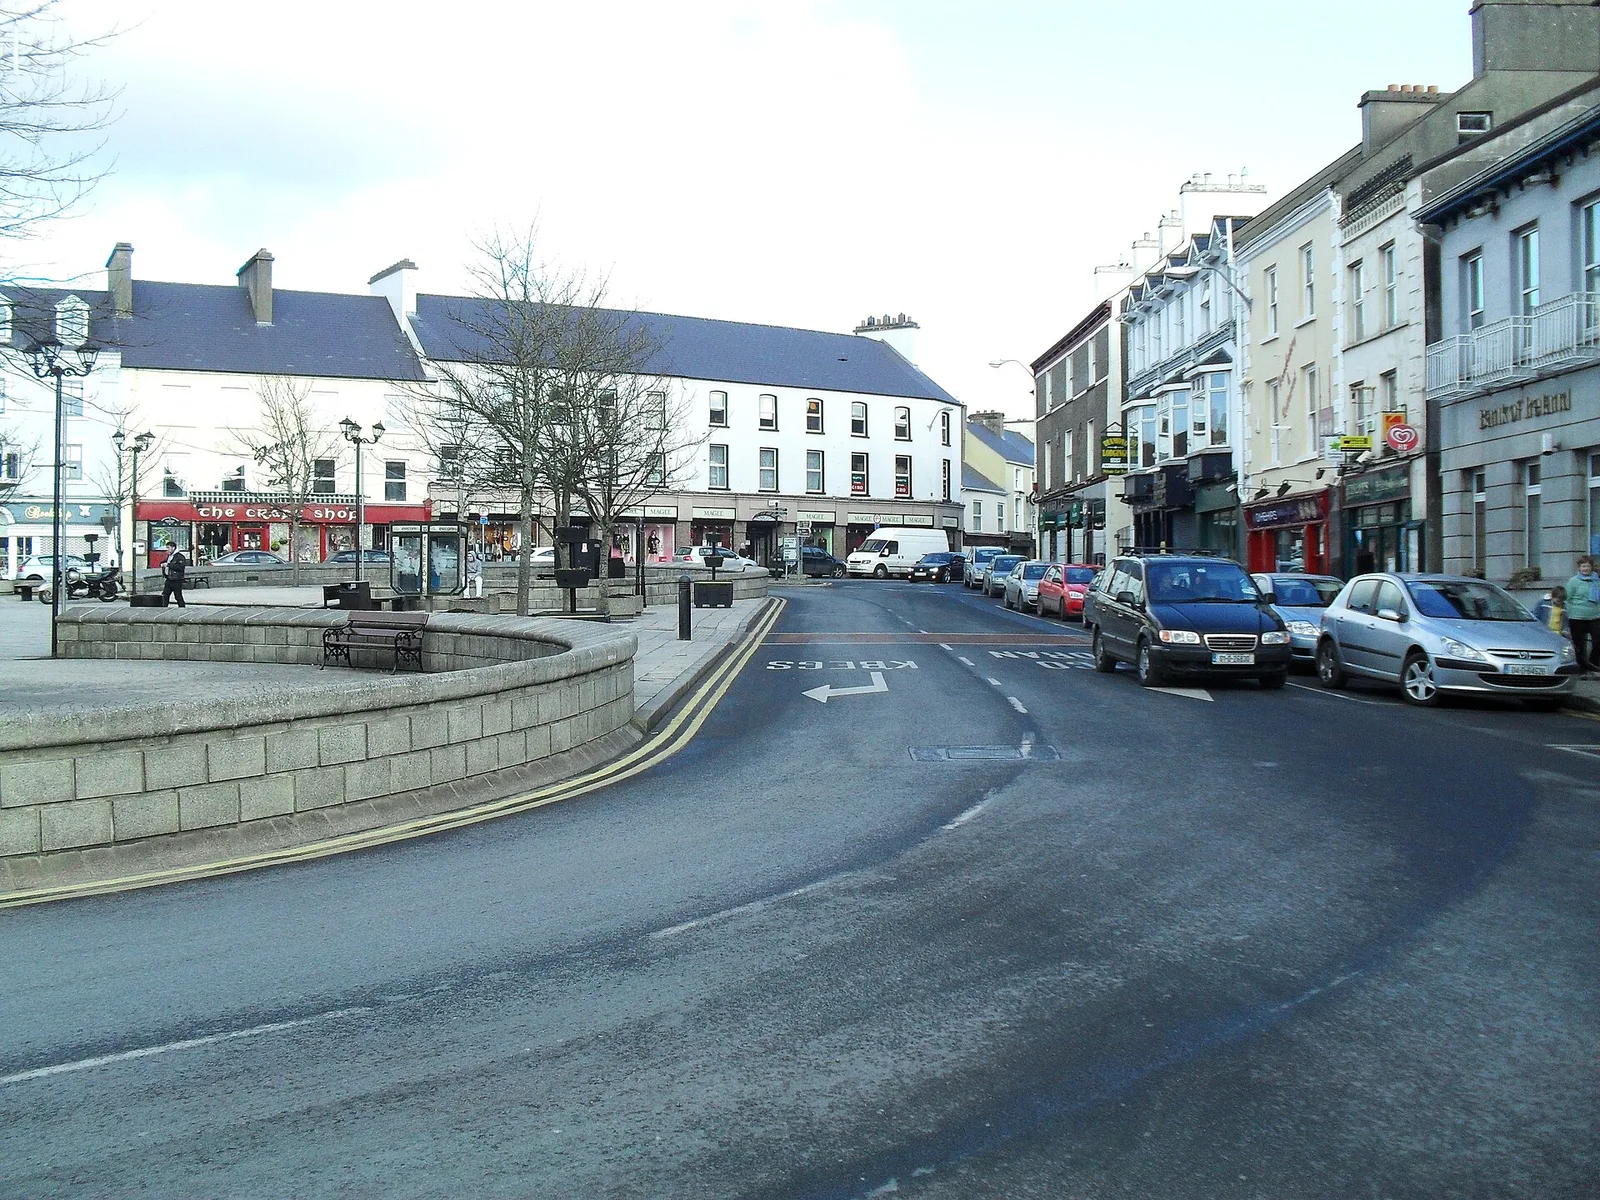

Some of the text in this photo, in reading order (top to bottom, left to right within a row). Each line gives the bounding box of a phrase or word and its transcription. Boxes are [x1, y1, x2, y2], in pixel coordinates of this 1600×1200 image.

[1479, 388, 1571, 430] Bank of Ireland
